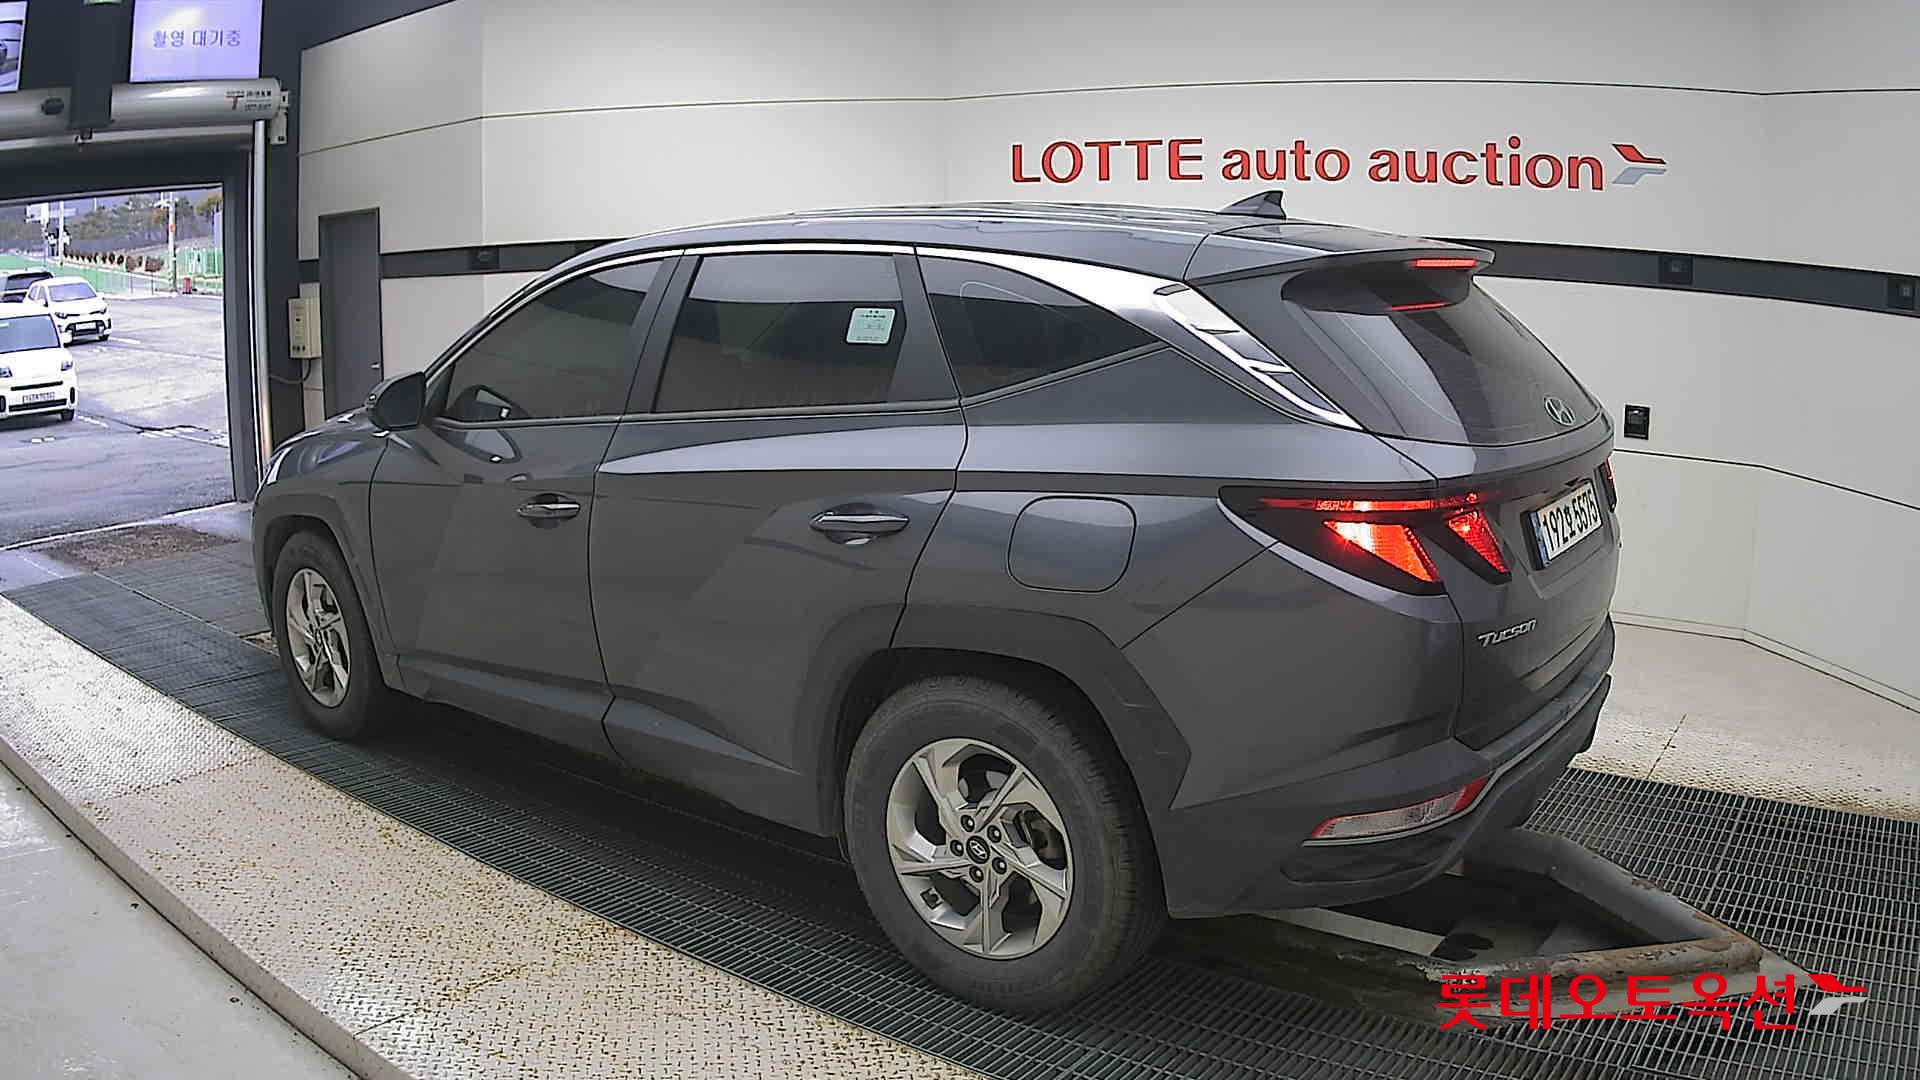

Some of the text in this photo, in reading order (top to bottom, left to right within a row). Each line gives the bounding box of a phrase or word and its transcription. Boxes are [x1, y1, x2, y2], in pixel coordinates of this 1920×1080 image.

[192, 29, 241, 48] 대기중
[1011, 135, 1604, 191] LOTTE auto auction
